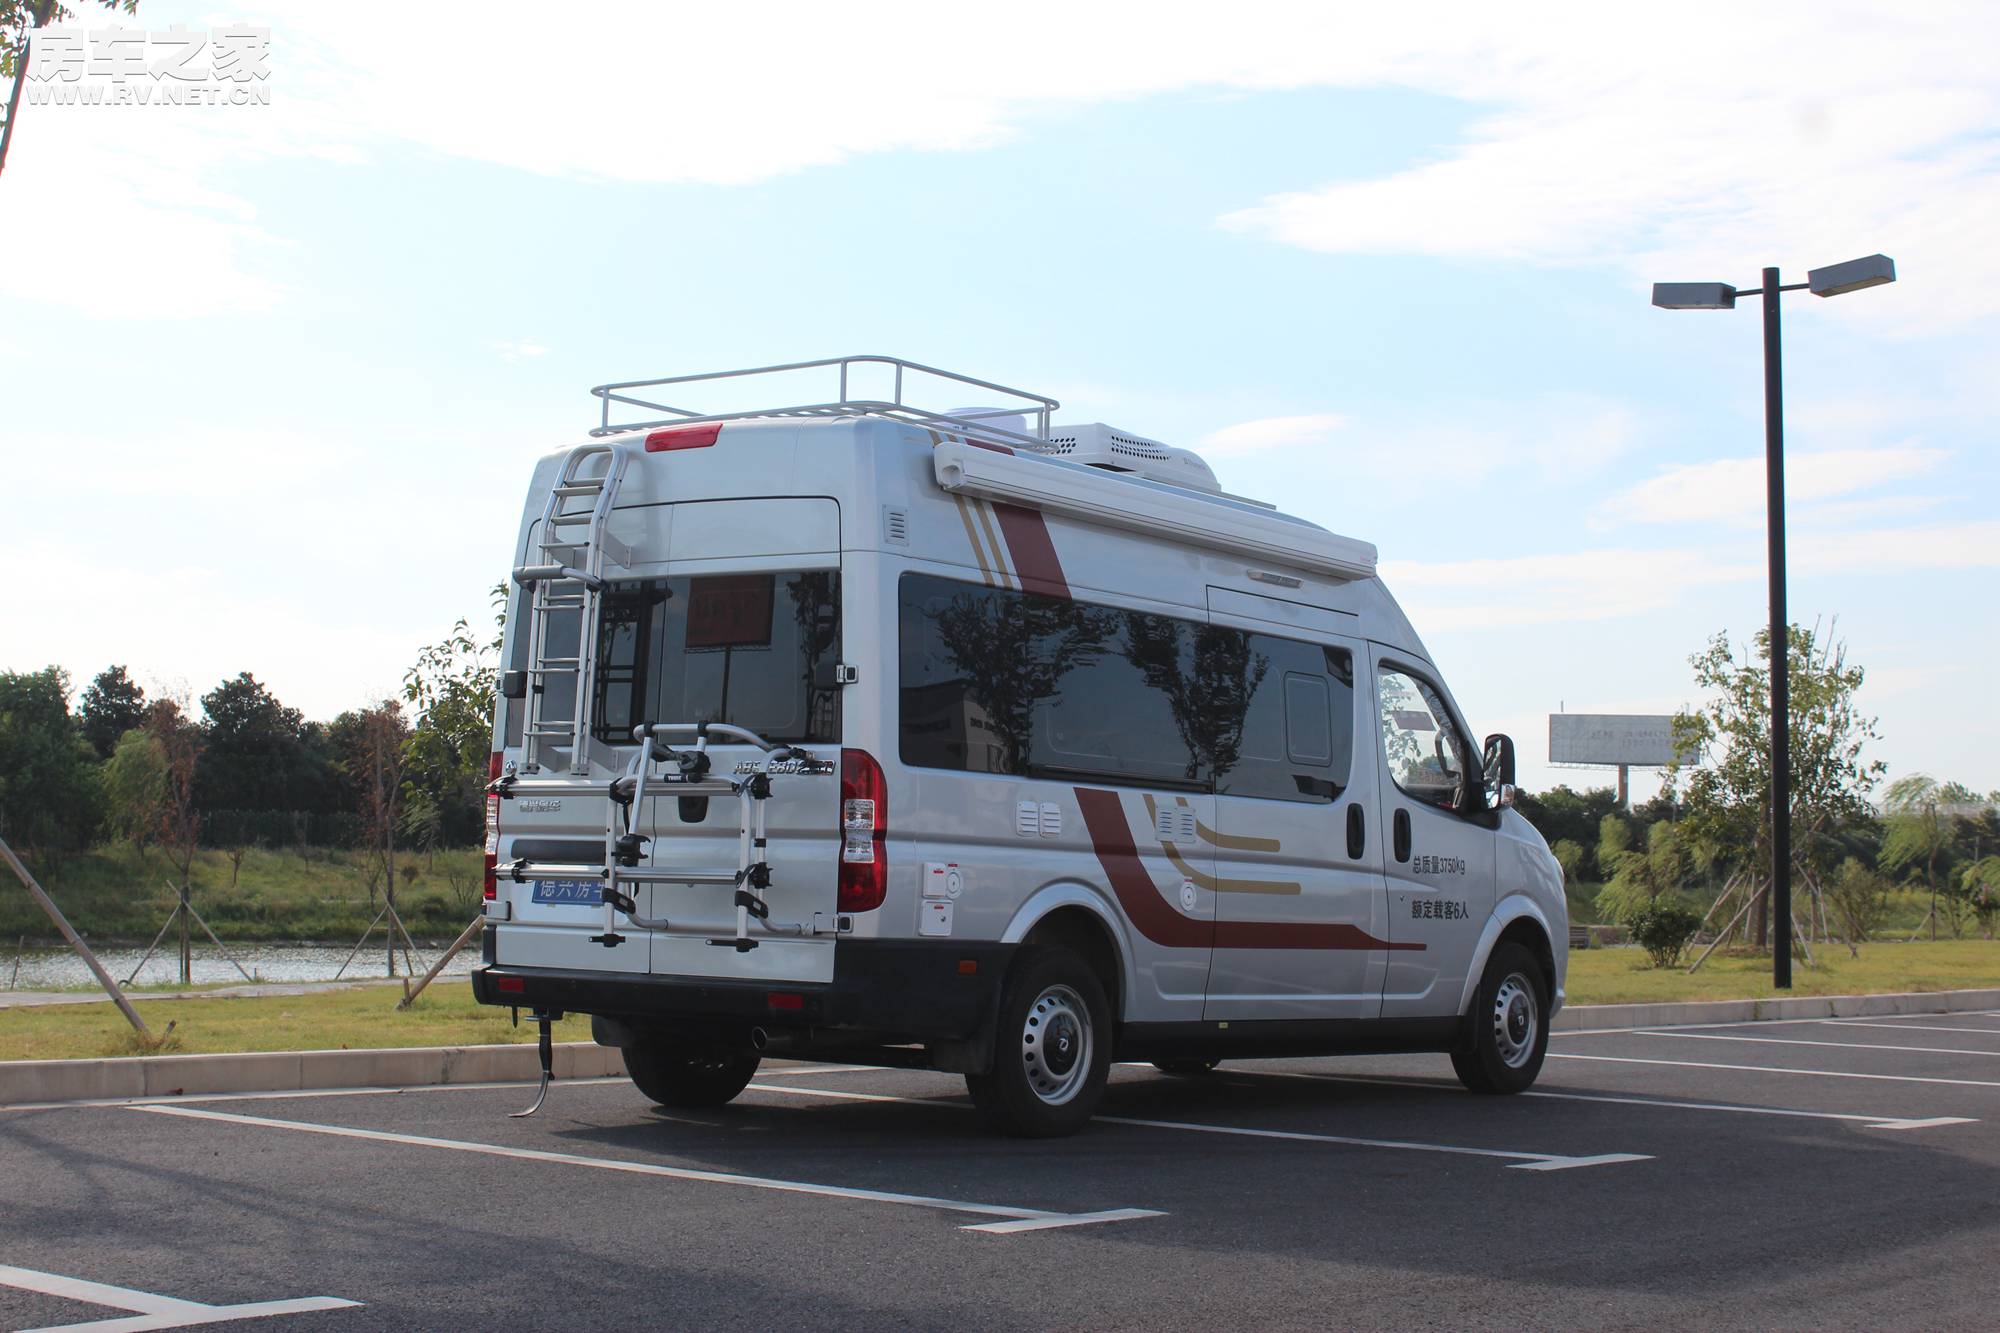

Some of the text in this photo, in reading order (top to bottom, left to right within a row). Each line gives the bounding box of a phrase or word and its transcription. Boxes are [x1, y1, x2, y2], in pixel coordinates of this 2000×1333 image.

[1412, 900, 1469, 919] 额定载客6人
